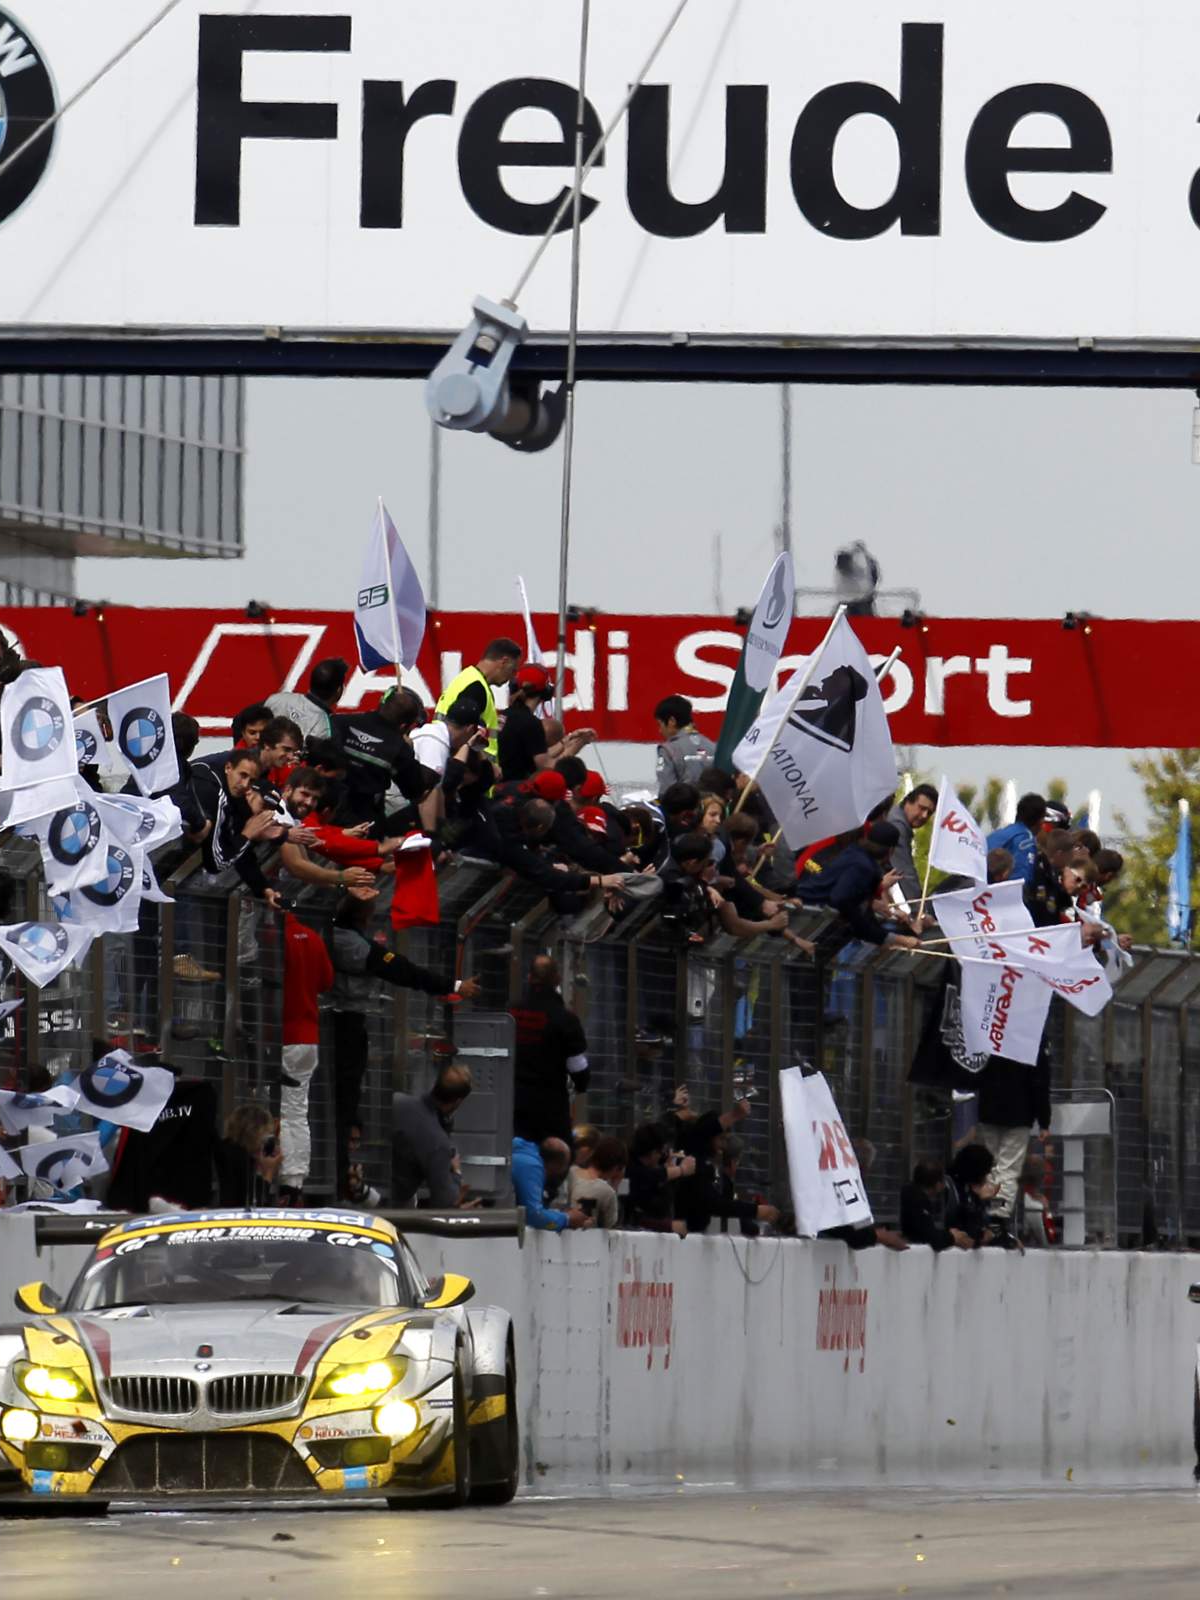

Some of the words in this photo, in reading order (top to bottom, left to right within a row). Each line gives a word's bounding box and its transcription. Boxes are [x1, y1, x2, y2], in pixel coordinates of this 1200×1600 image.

[193, 13, 1113, 243] Freude
[200, 1211, 365, 1225] randstad
[168, 1228, 226, 1242] GRAN
[228, 1226, 316, 1239] TURISMO
